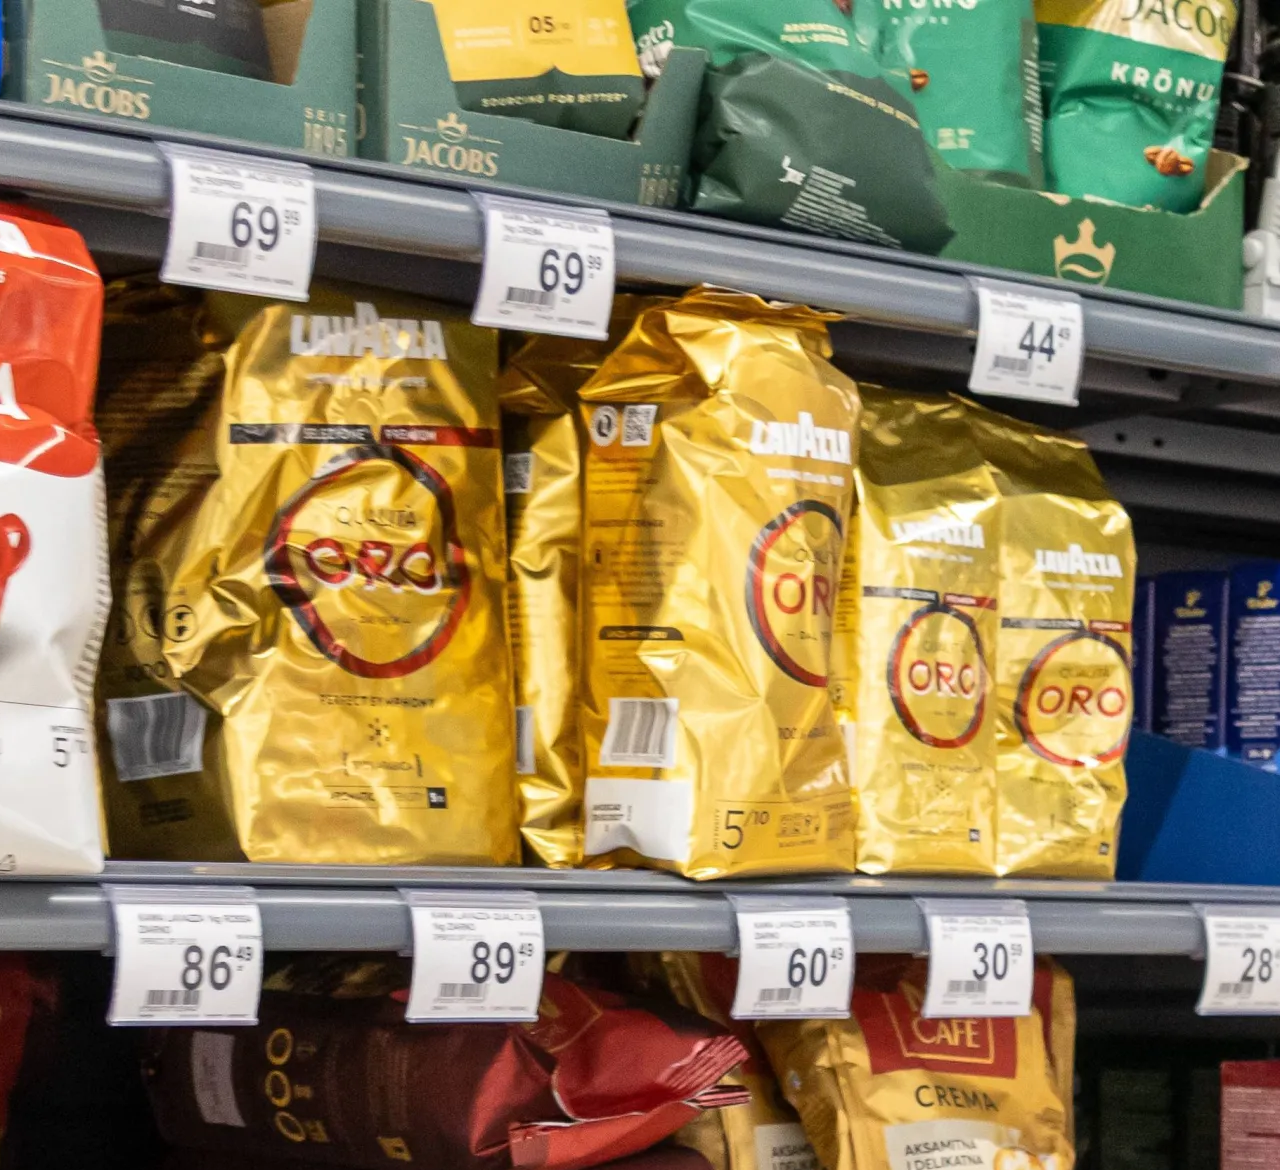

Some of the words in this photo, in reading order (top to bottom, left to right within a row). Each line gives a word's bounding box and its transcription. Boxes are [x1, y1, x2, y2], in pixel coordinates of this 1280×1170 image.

[42, 73, 151, 120] JACOBS
[548, 93, 574, 104] FOR
[402, 136, 499, 178] JACOBS
[231, 202, 279, 250] 69
[538, 249, 583, 296] 69
[290, 301, 448, 361] LAVAZZA
[1019, 321, 1055, 363] 44
[304, 538, 443, 596] ORO
[1034, 543, 1124, 578] LAVAZZA
[1036, 684, 1126, 718] ORO
[53, 737, 70, 768] 5
[722, 810, 745, 850] 5
[182, 945, 232, 991] 86
[470, 941, 515, 985] 89
[788, 947, 827, 988] 60
[972, 942, 1009, 982] 30
[1241, 949, 1271, 983] 28
[914, 1084, 1000, 1112] CREMA
[904, 1139, 978, 1157] AKSAMITNA
